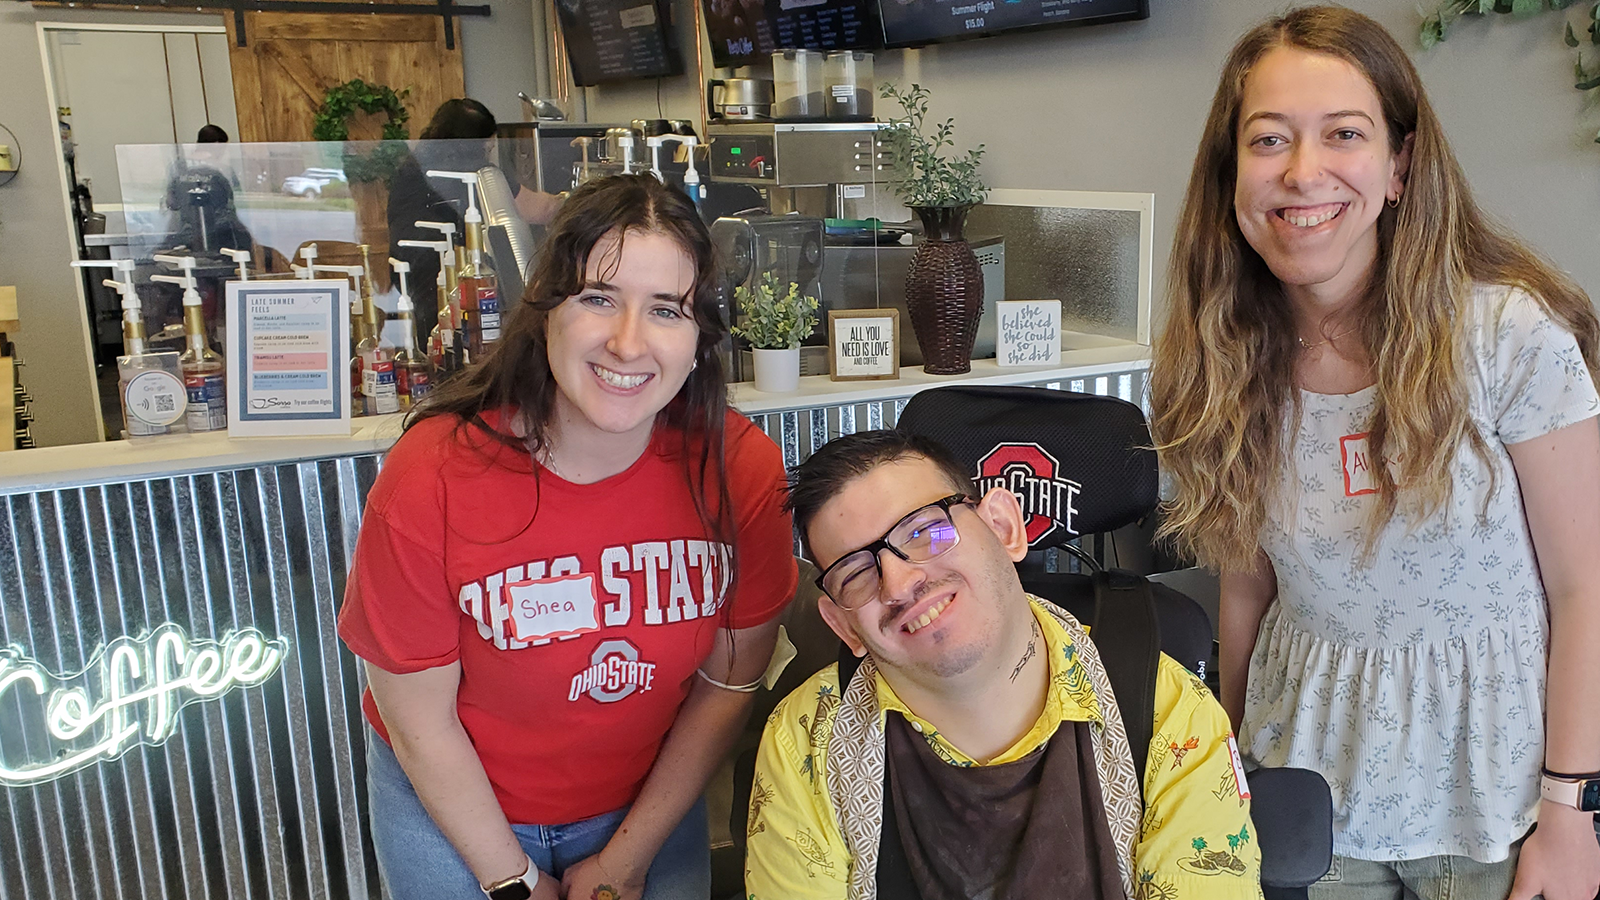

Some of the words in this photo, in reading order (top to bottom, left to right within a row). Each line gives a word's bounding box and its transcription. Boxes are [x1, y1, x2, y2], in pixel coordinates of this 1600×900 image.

[951, 5, 977, 16] Summer
[977, 1, 995, 14] Flight
[965, 17, 985, 29] $15.00
[269, 297, 295, 305] SUMMER
[1020, 304, 1042, 320] she
[1002, 311, 1053, 331] believed
[850, 326, 864, 341] ALL
[865, 326, 880, 341] YOU
[1003, 329, 1024, 344] she
[841, 342, 861, 357] NEED
[862, 342, 870, 357] IS
[871, 341, 890, 356] LOVE
[1007, 349, 1028, 365] she
[1028, 343, 1054, 362] did
[1016, 341, 1033, 352] so
[853, 357, 863, 365] AND
[863, 356, 878, 365] COFFEE
[1009, 470, 1082, 536] STATE
[520, 599, 576, 619] Shea
[568, 662, 608, 702] OHIO
[608, 656, 656, 690] STATE
